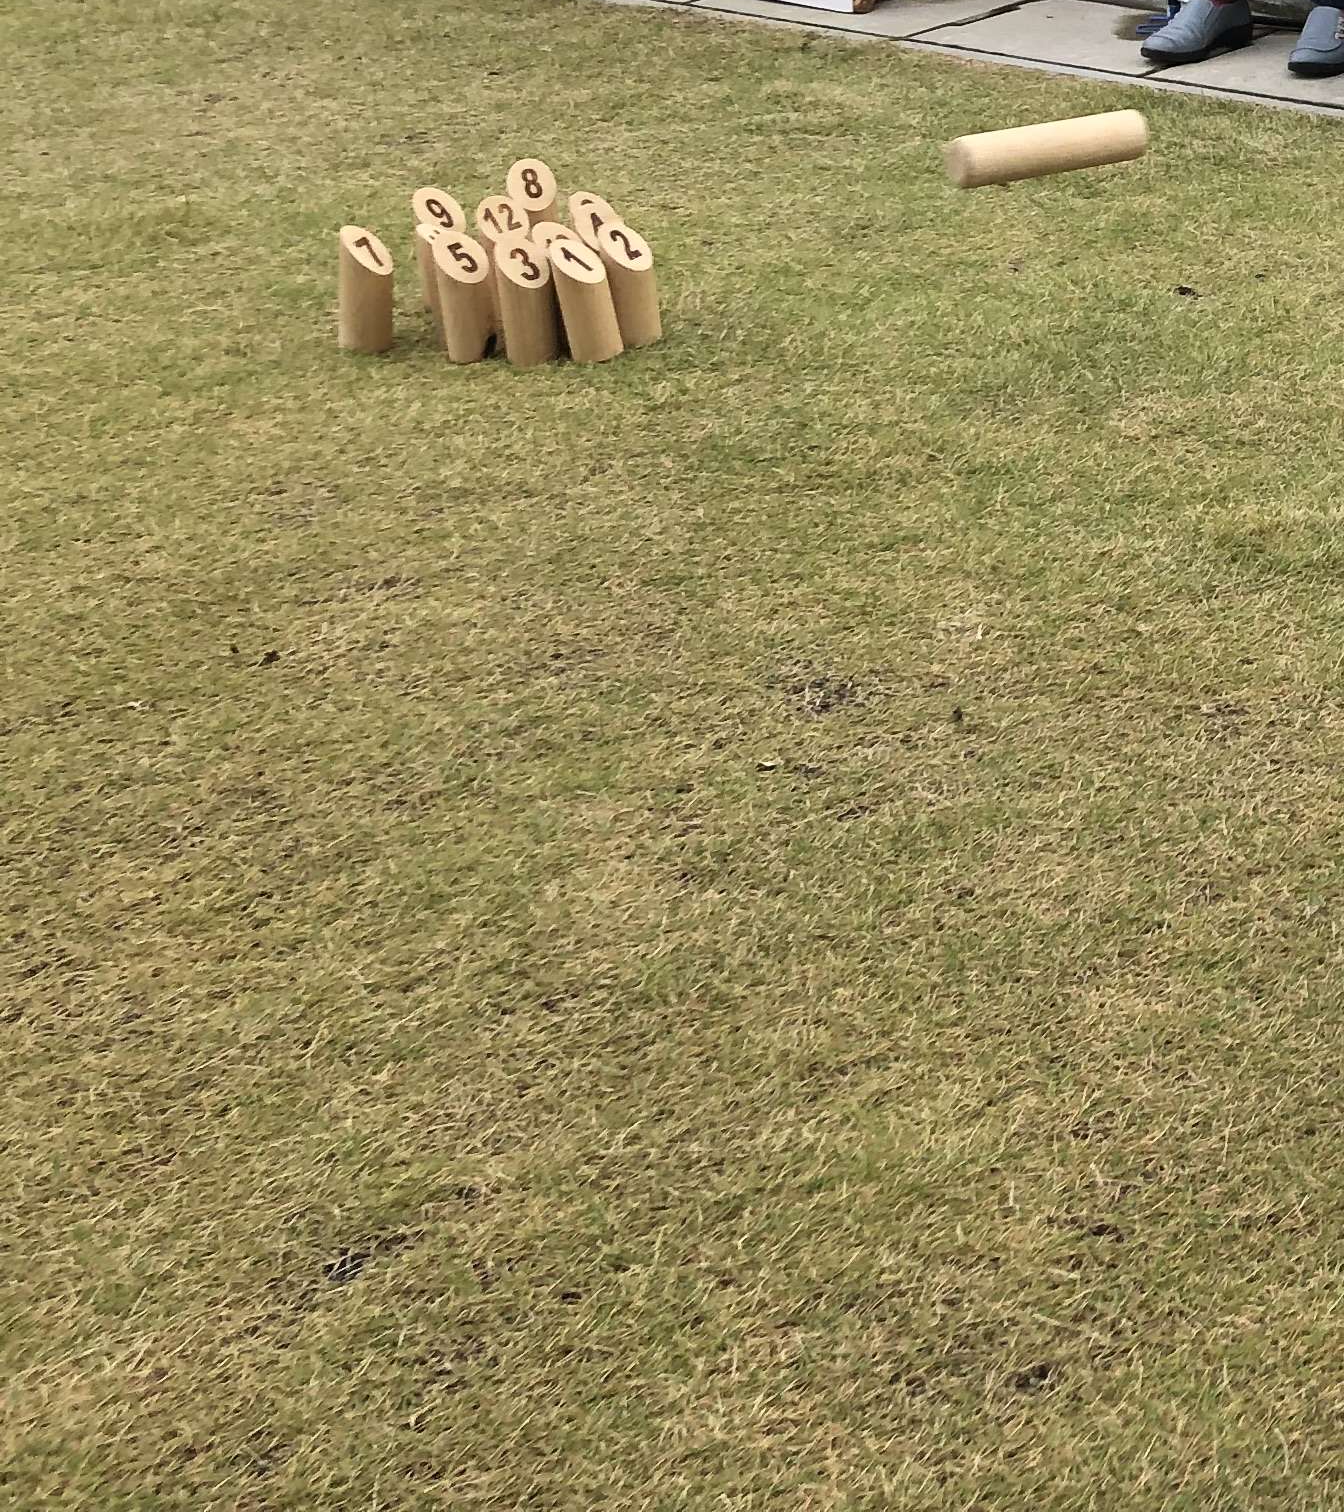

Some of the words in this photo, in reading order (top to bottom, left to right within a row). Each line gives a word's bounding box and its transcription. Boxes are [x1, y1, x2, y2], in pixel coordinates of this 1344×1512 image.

[521, 168, 543, 199] 8
[425, 199, 454, 228] 9
[483, 204, 523, 234] 12
[354, 236, 385, 267] 7
[447, 242, 478, 273] 5
[560, 247, 594, 271] 1
[609, 230, 642, 260] 2
[510, 248, 540, 280] 3
